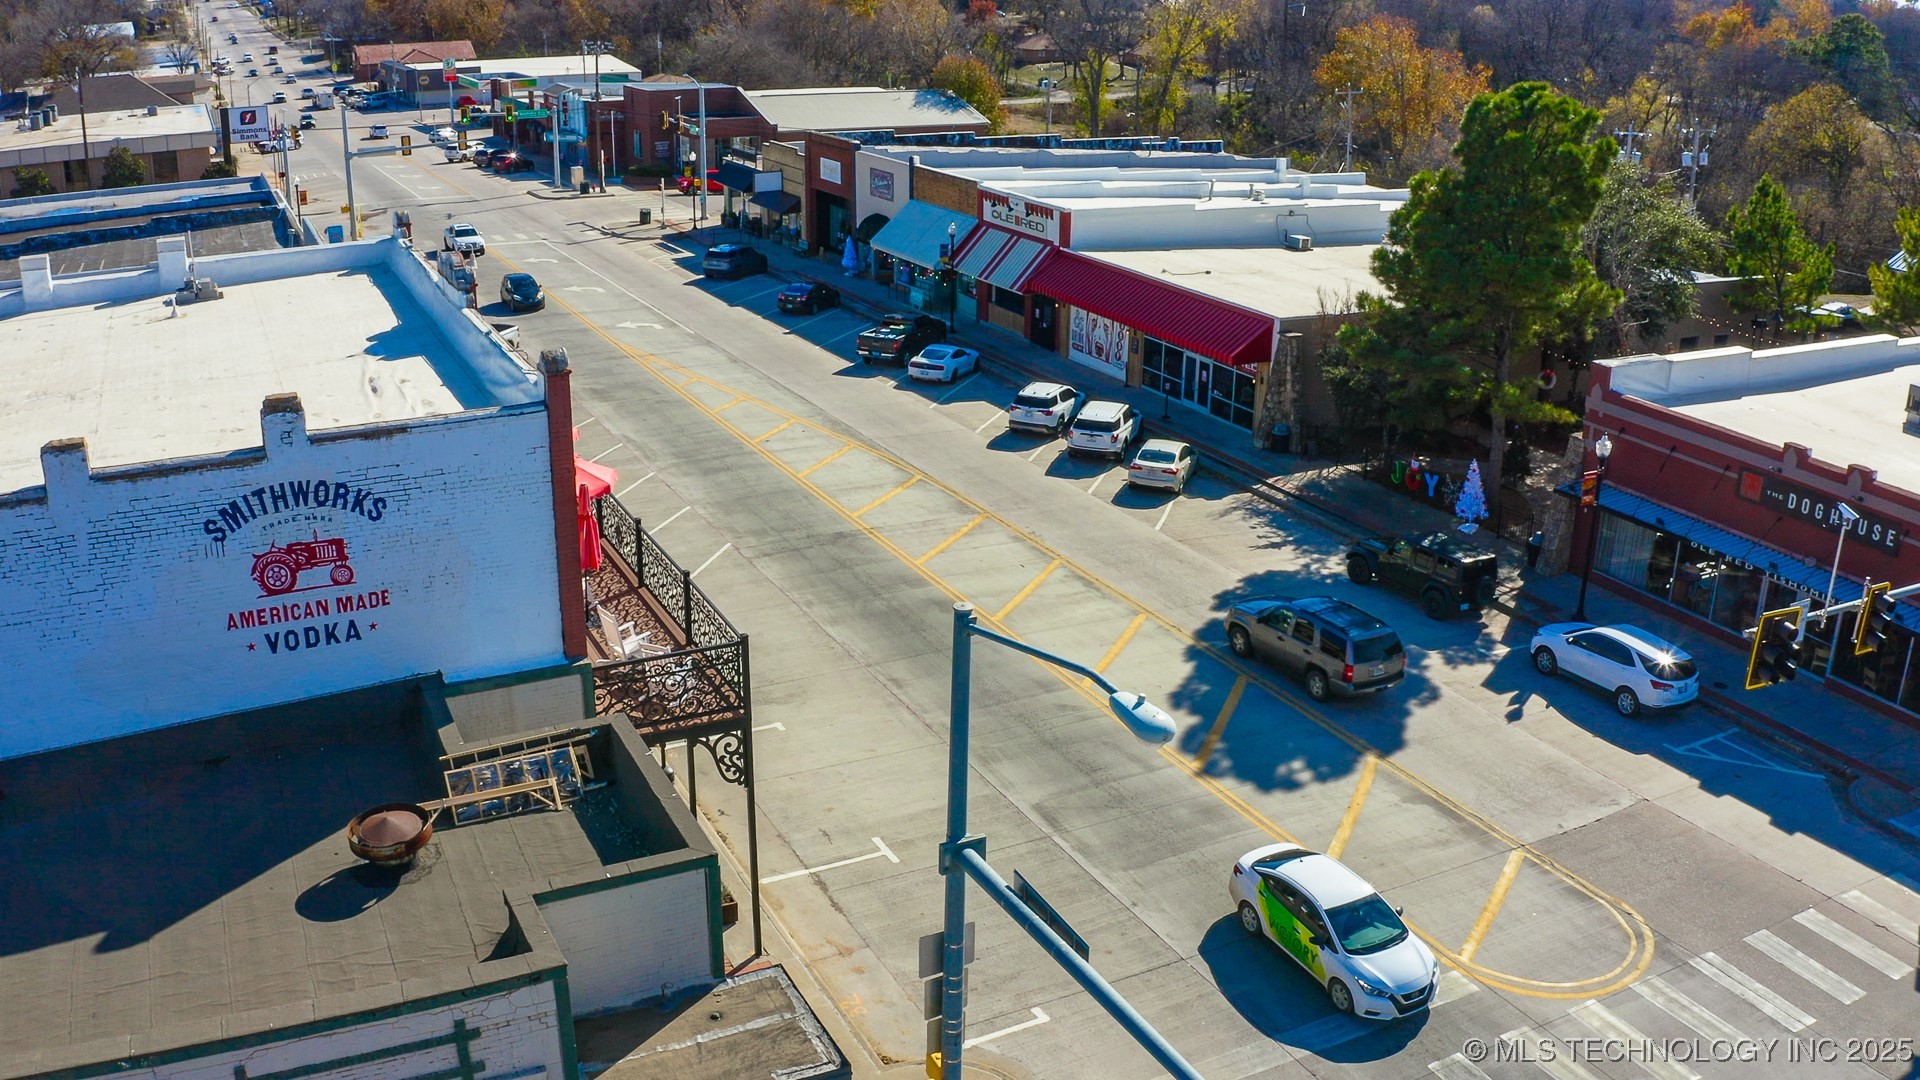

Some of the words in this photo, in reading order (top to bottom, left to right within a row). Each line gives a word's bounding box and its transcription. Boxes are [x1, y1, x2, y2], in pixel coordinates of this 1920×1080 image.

[231, 127, 267, 135] Simmons
[991, 209, 1014, 224] OLE
[1020, 217, 1045, 233] RED
[1391, 460, 1439, 497] JOY
[203, 480, 388, 543] SMITHWORKS
[1766, 490, 1784, 501] THE
[262, 516, 298, 532] TRADE
[1690, 541, 1716, 556] OLE
[1724, 555, 1754, 571] RED
[227, 598, 330, 631] AMERICAN
[336, 589, 391, 614] MADE
[264, 619, 362, 655] VODKA
[1268, 914, 1318, 964] VICTORY
